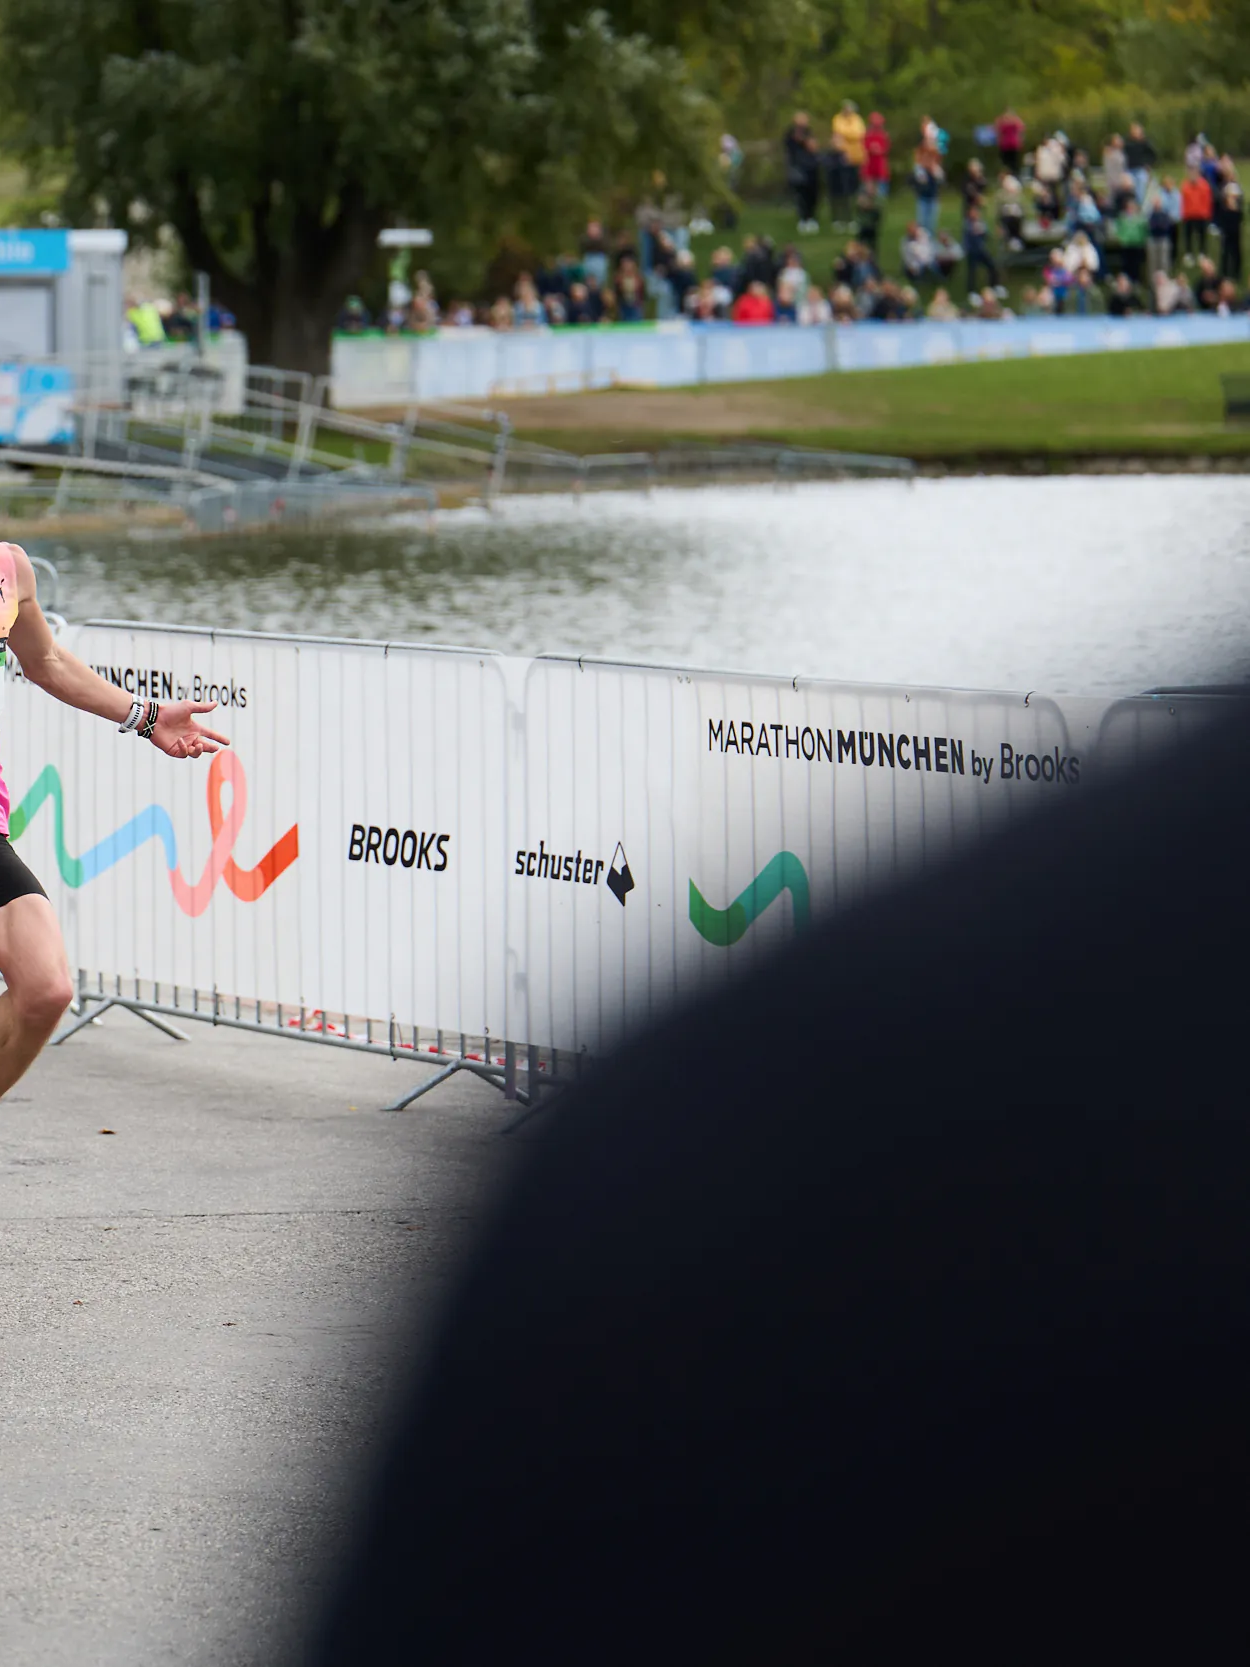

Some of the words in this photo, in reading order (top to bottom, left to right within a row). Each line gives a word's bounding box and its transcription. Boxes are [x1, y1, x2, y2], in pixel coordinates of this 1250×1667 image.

[194, 674, 247, 707] Brooks
[971, 750, 994, 785] by
[1000, 743, 1081, 785] Brooks
[349, 824, 450, 872] BROOKS
[514, 840, 604, 885] schuster
